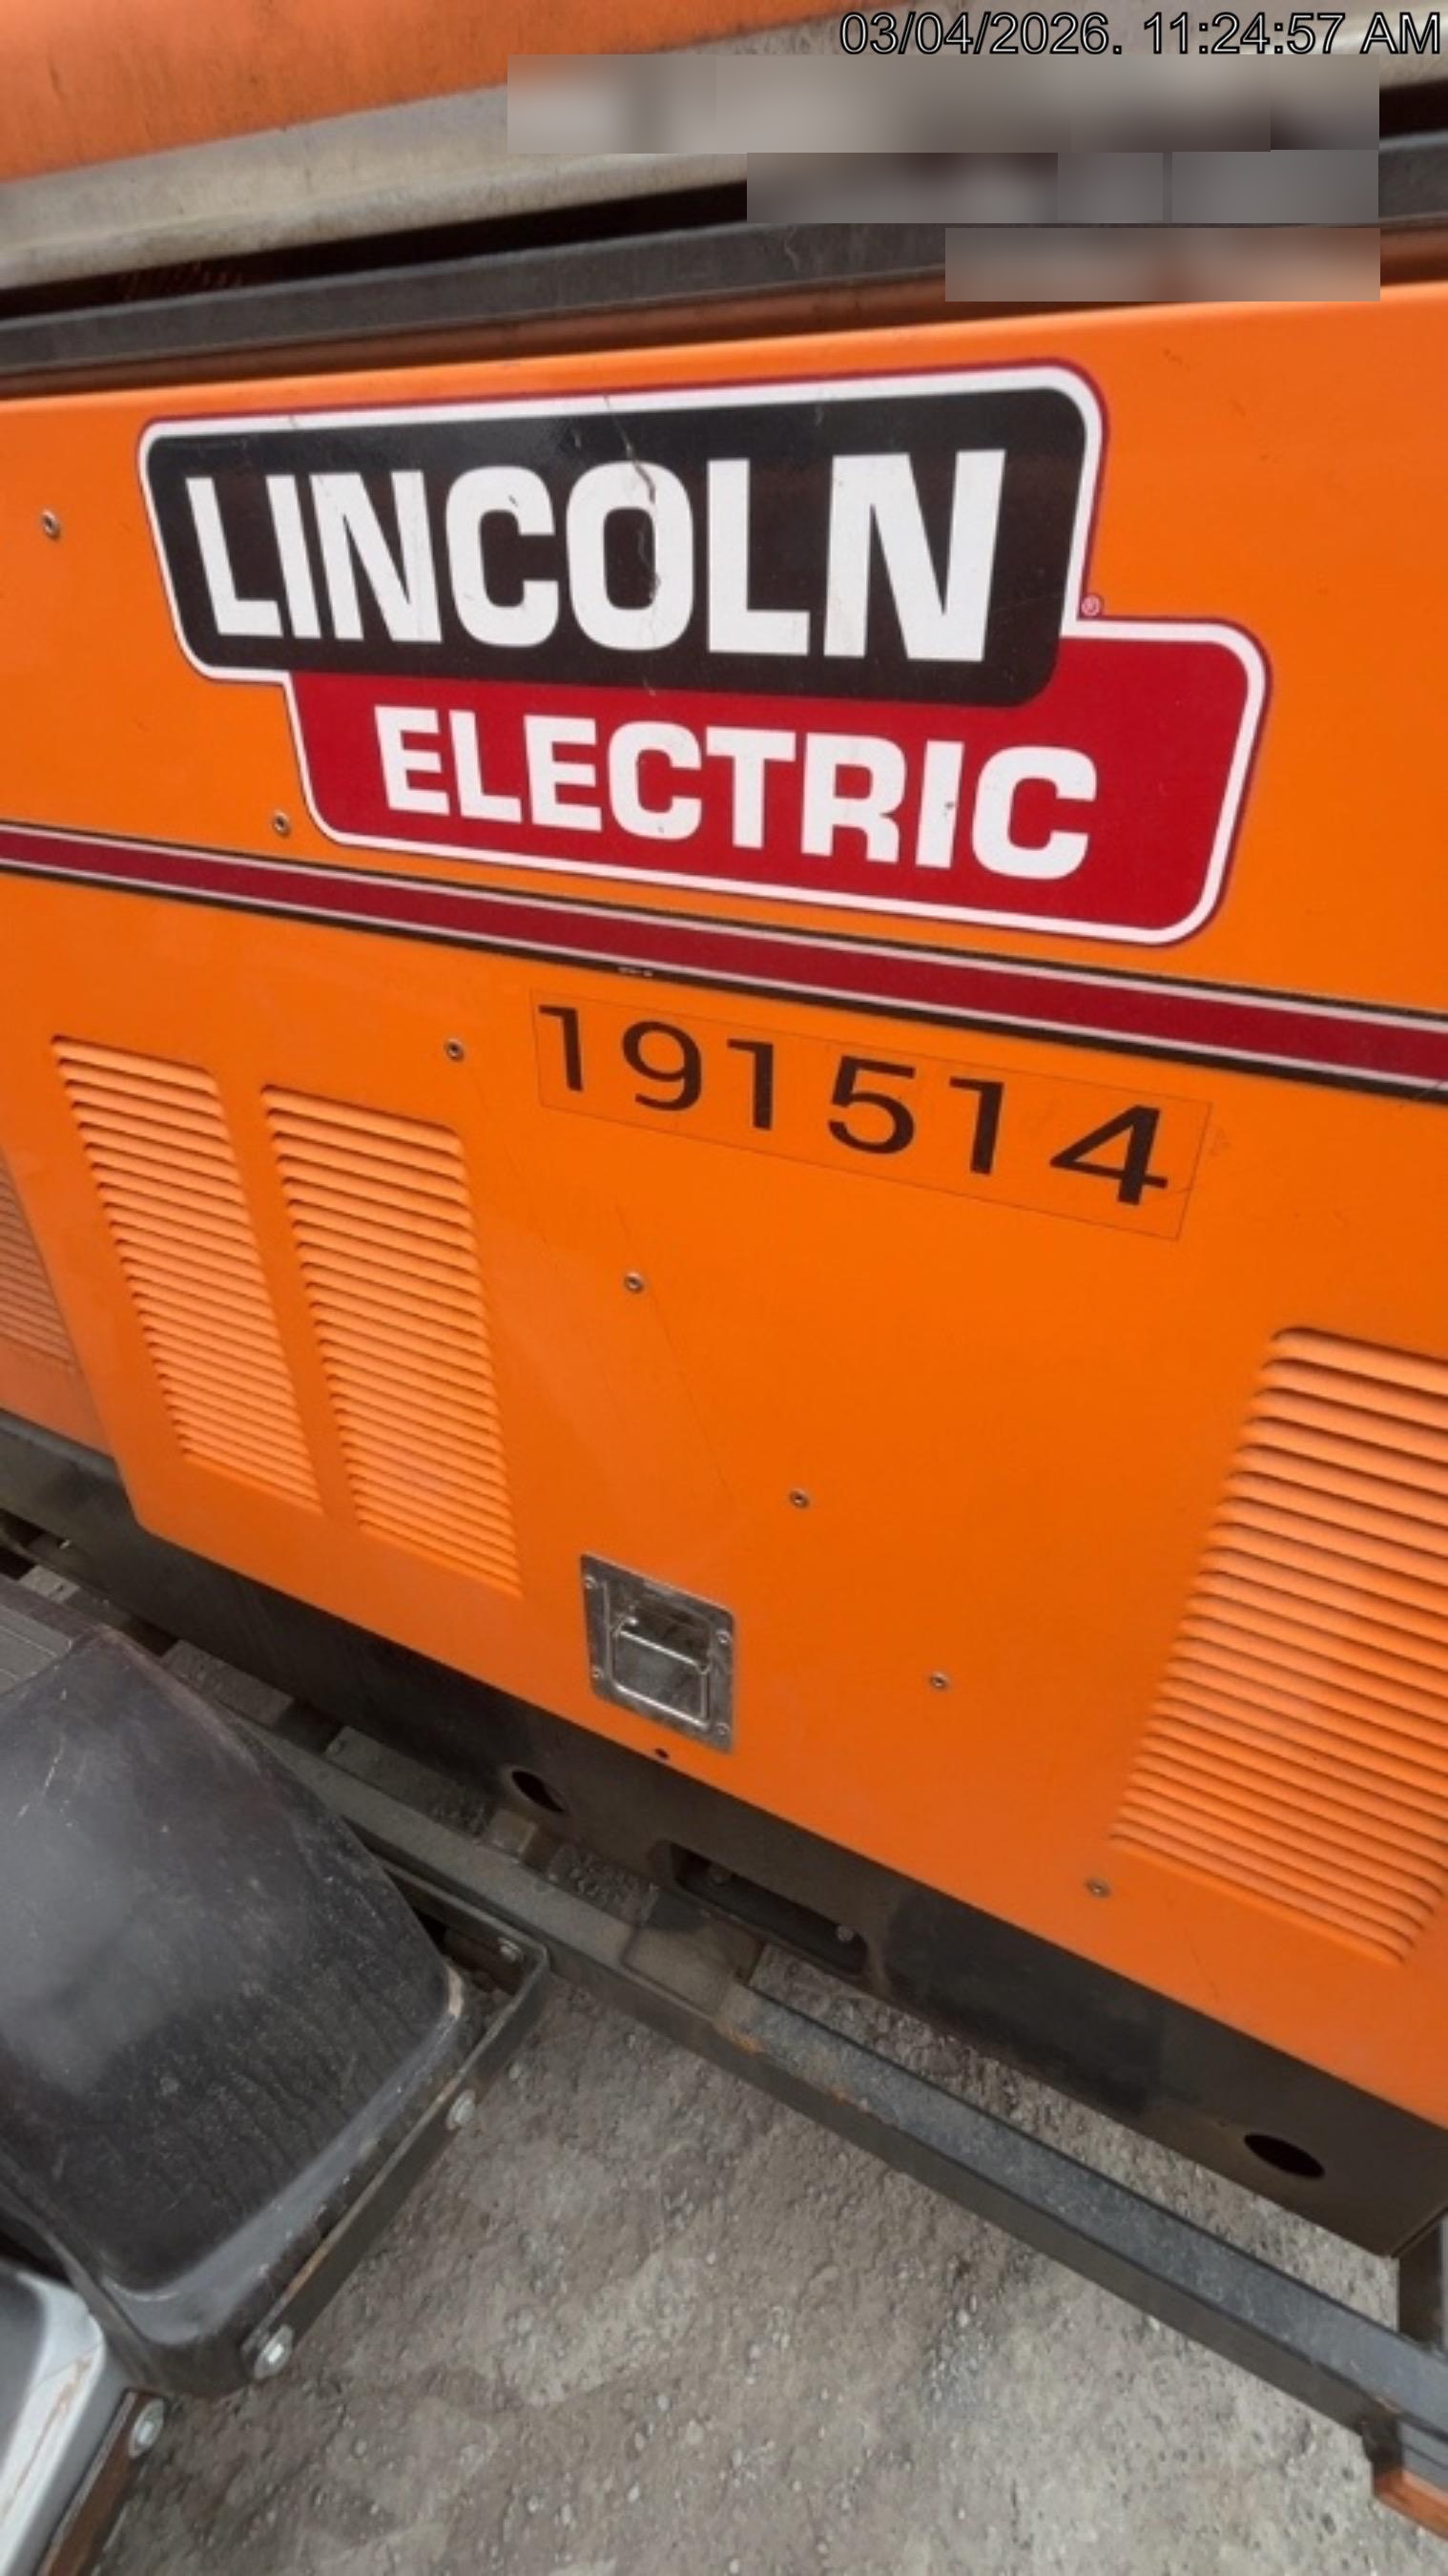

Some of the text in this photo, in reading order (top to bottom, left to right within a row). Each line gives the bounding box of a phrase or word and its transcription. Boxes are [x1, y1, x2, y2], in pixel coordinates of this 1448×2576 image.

[186, 449, 1005, 662] LINCOLN
[374, 705, 1097, 880] ELECTRIC
[538, 1005, 1169, 1206] 191514
